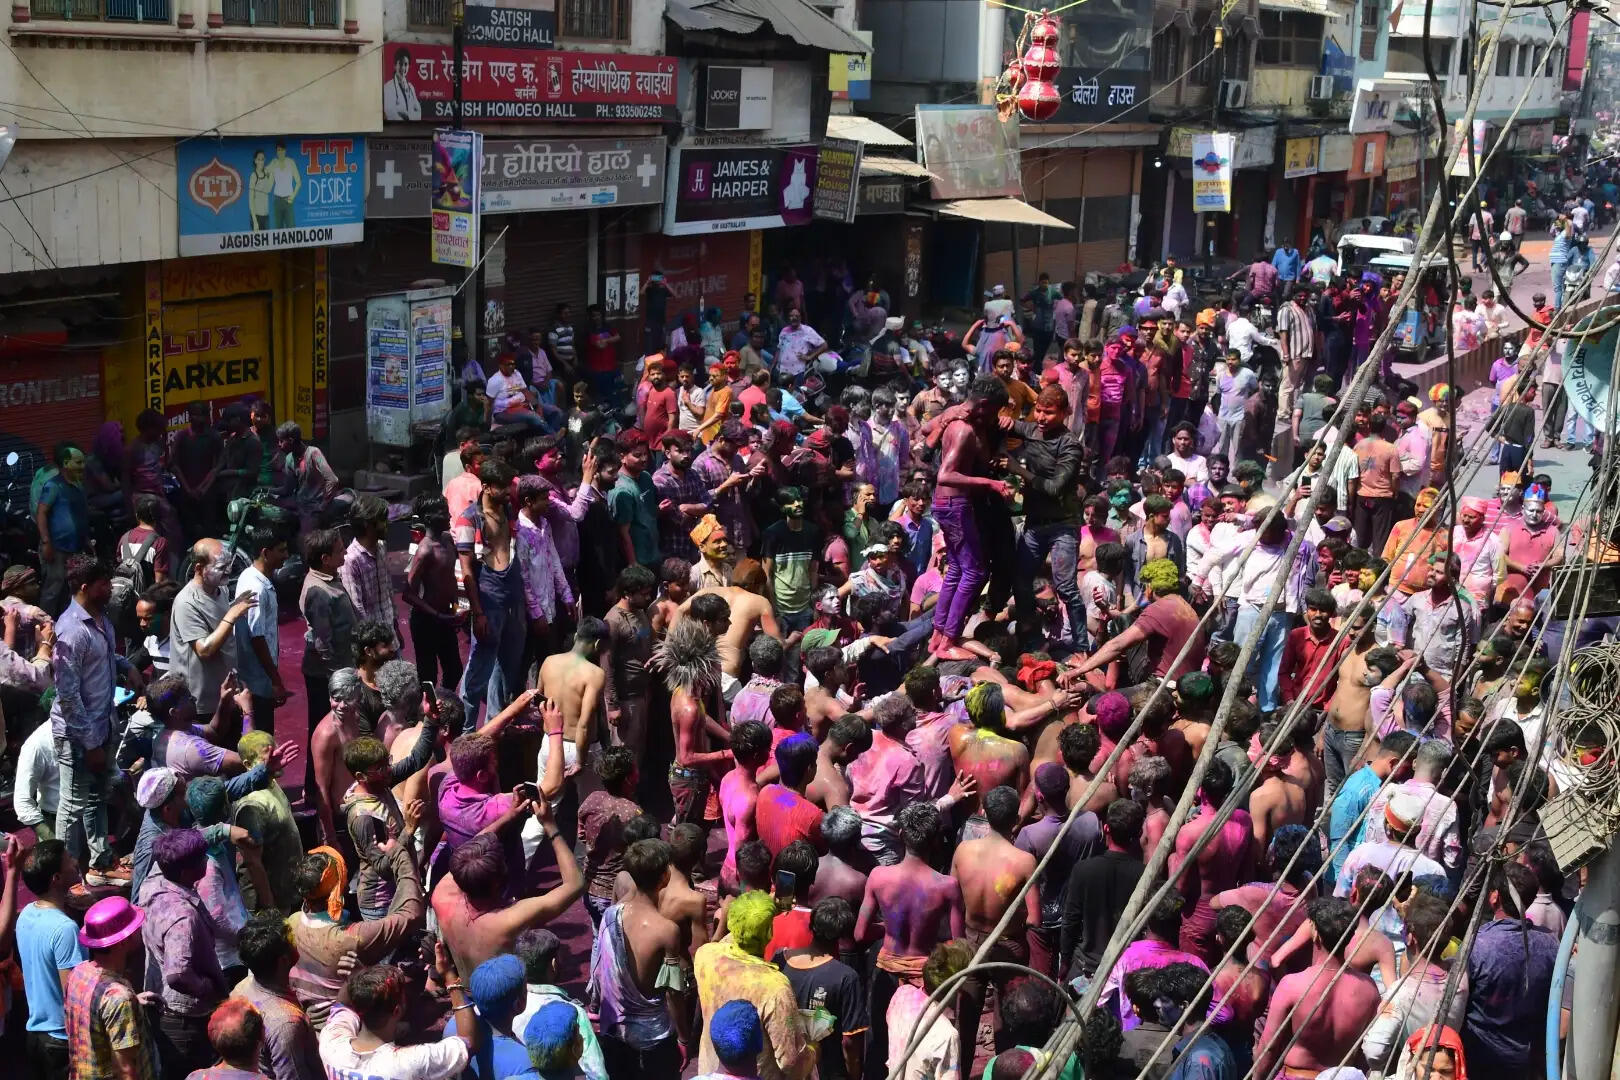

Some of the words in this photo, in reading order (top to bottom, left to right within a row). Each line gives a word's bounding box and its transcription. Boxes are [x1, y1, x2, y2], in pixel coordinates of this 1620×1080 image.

[490, 9, 532, 27] SATISH
[467, 25, 521, 42] HOMOEO
[522, 28, 553, 44] HALL
[416, 58, 439, 81] डा.
[488, 61, 518, 87] एण्ड
[521, 62, 539, 84] क.
[635, 62, 674, 99] दवाईयाँ
[514, 84, 537, 100] जर्मनी
[710, 90, 738, 100] JOCKEY
[1072, 75, 1100, 105] ज्वेलरी
[1107, 85, 1136, 106] हाउस
[486, 102, 542, 117] HOMOEO
[545, 103, 577, 118] HALL
[615, 105, 662, 119] 9335002453
[300, 138, 358, 176] T.T.
[713, 160, 759, 178] JAMES
[759, 159, 770, 176] &
[819, 164, 850, 180] Guest
[198, 174, 235, 199] T.T.
[308, 177, 353, 205] DESIRE
[711, 180, 769, 199] HARPER
[818, 176, 849, 192] House
[219, 233, 269, 250] JAGDISH
[272, 228, 334, 246] HANDLOOM
[163, 325, 242, 357] LUX
